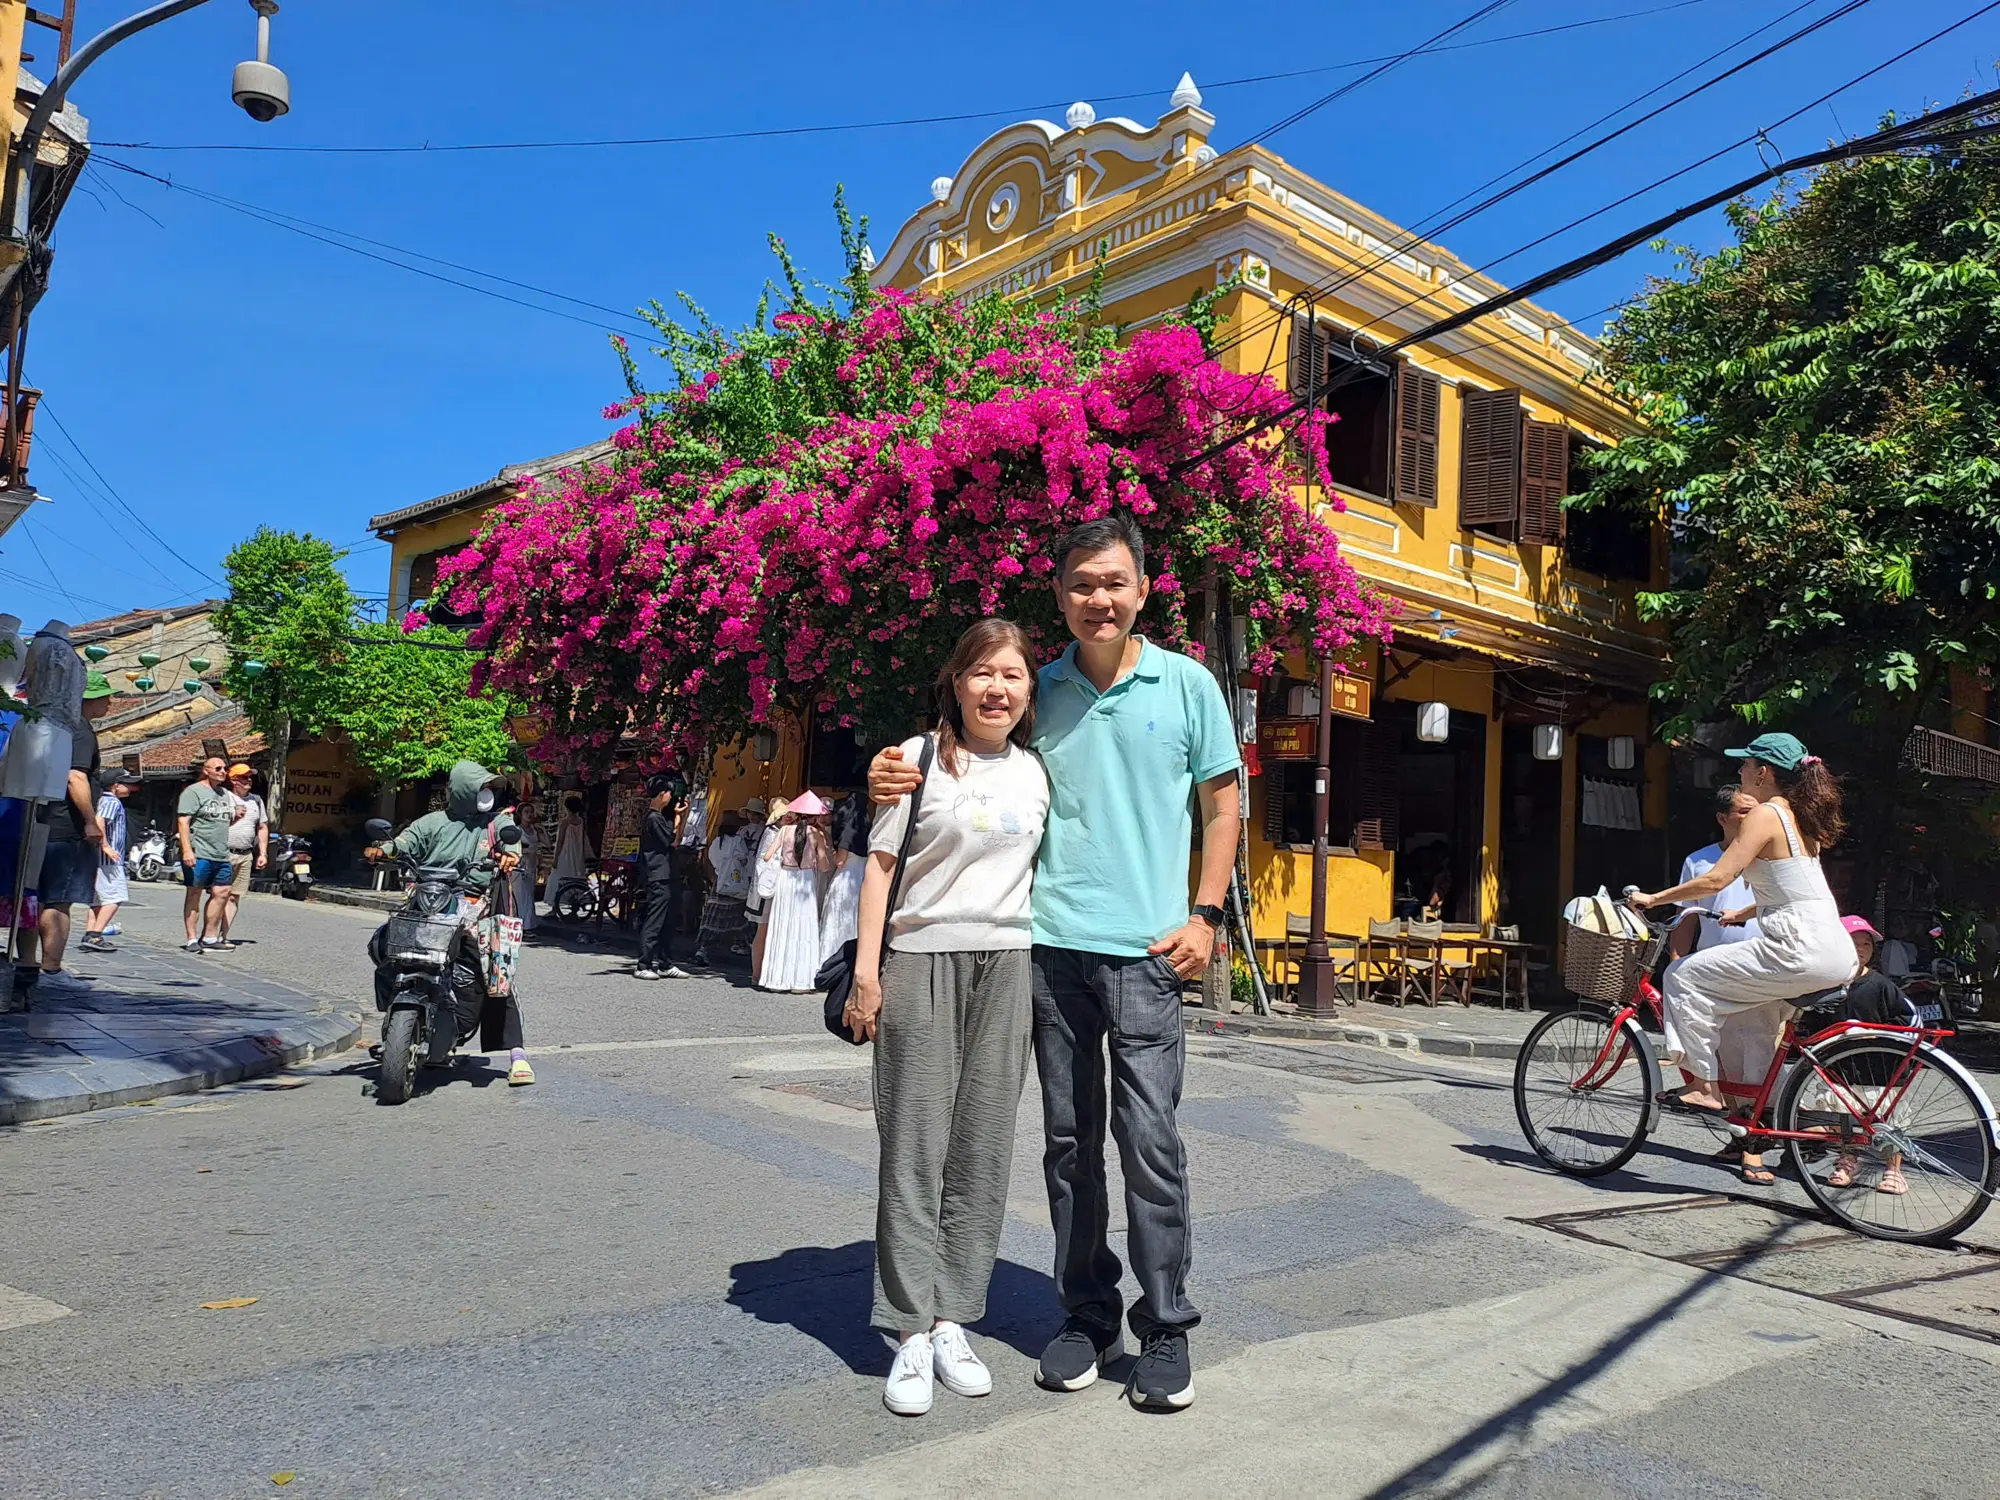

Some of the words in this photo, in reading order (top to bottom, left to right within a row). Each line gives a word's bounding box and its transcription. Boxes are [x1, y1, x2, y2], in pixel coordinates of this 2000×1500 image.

[289, 769, 329, 778] WELCOME
[329, 771, 341, 779] TO
[287, 783, 310, 796] HOI
[313, 784, 332, 797] AN
